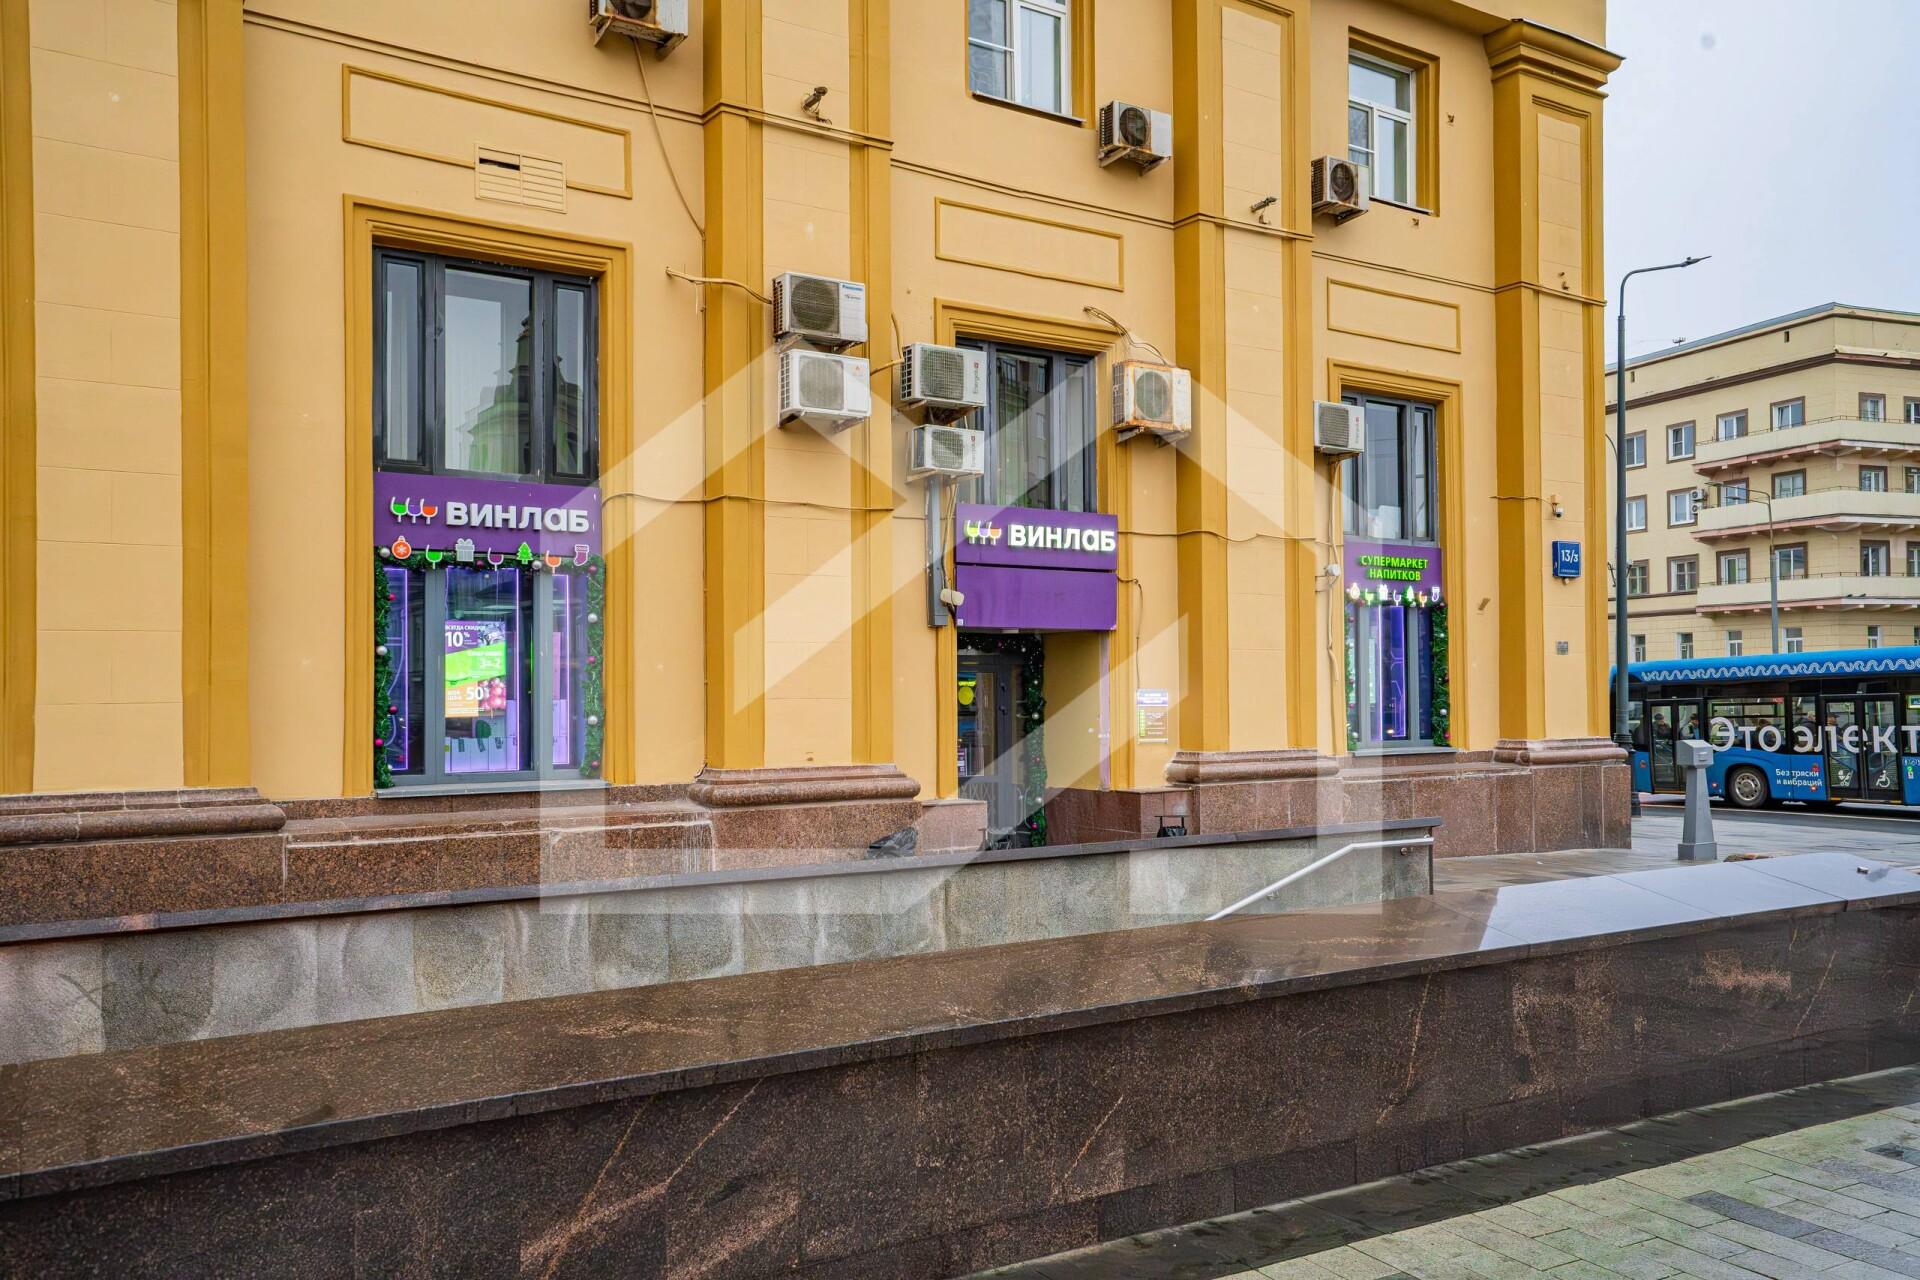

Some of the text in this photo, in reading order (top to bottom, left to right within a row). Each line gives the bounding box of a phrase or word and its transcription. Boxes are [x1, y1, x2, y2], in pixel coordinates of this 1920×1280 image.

[1361, 555, 1428, 569] СУПЕРМАРКЕТ
[1561, 549, 1579, 564] 13/3
[1369, 568, 1421, 581] НАПИТКОВ
[1710, 717, 1920, 753] Это элект
[1775, 769, 1819, 779] Без тряски
[1783, 778, 1822, 787] вибраций
